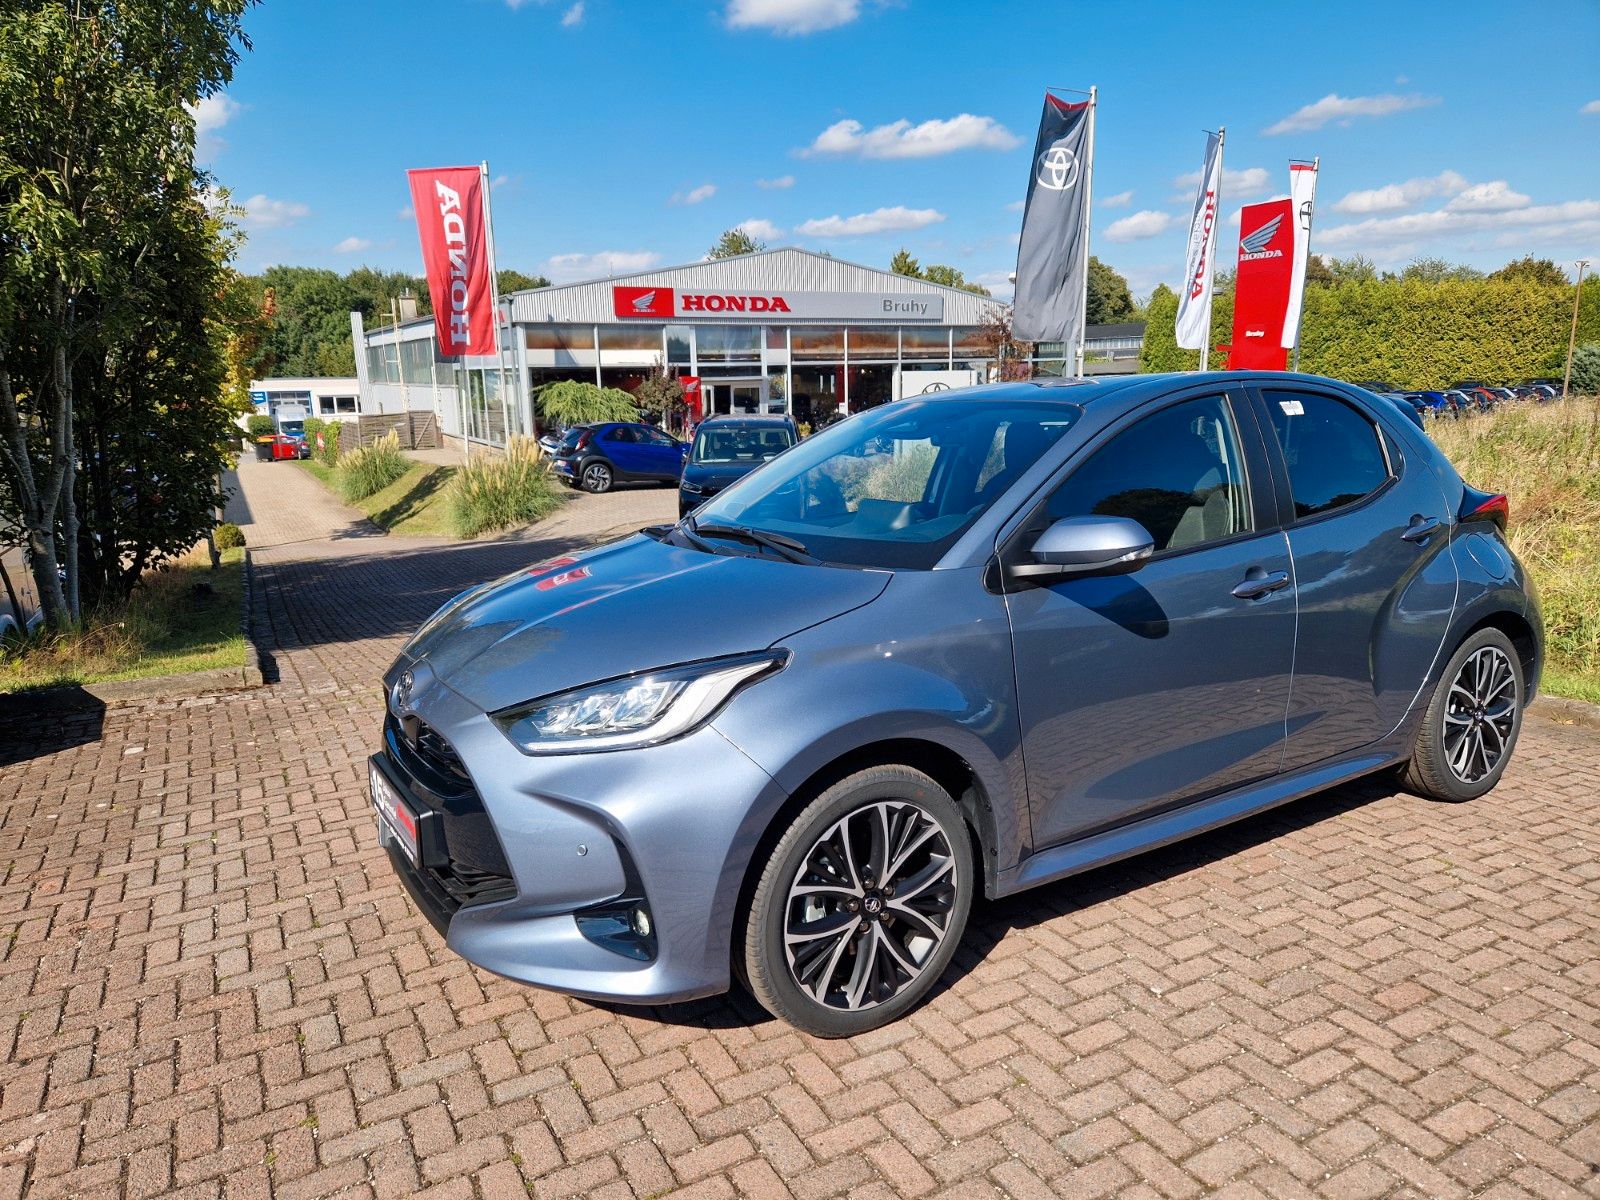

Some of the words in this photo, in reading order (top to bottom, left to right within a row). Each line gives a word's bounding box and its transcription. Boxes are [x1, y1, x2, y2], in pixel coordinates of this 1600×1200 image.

[1239, 249, 1283, 262] HONDA
[681, 294, 791, 313] HONDA
[882, 299, 928, 315] Bruhy
